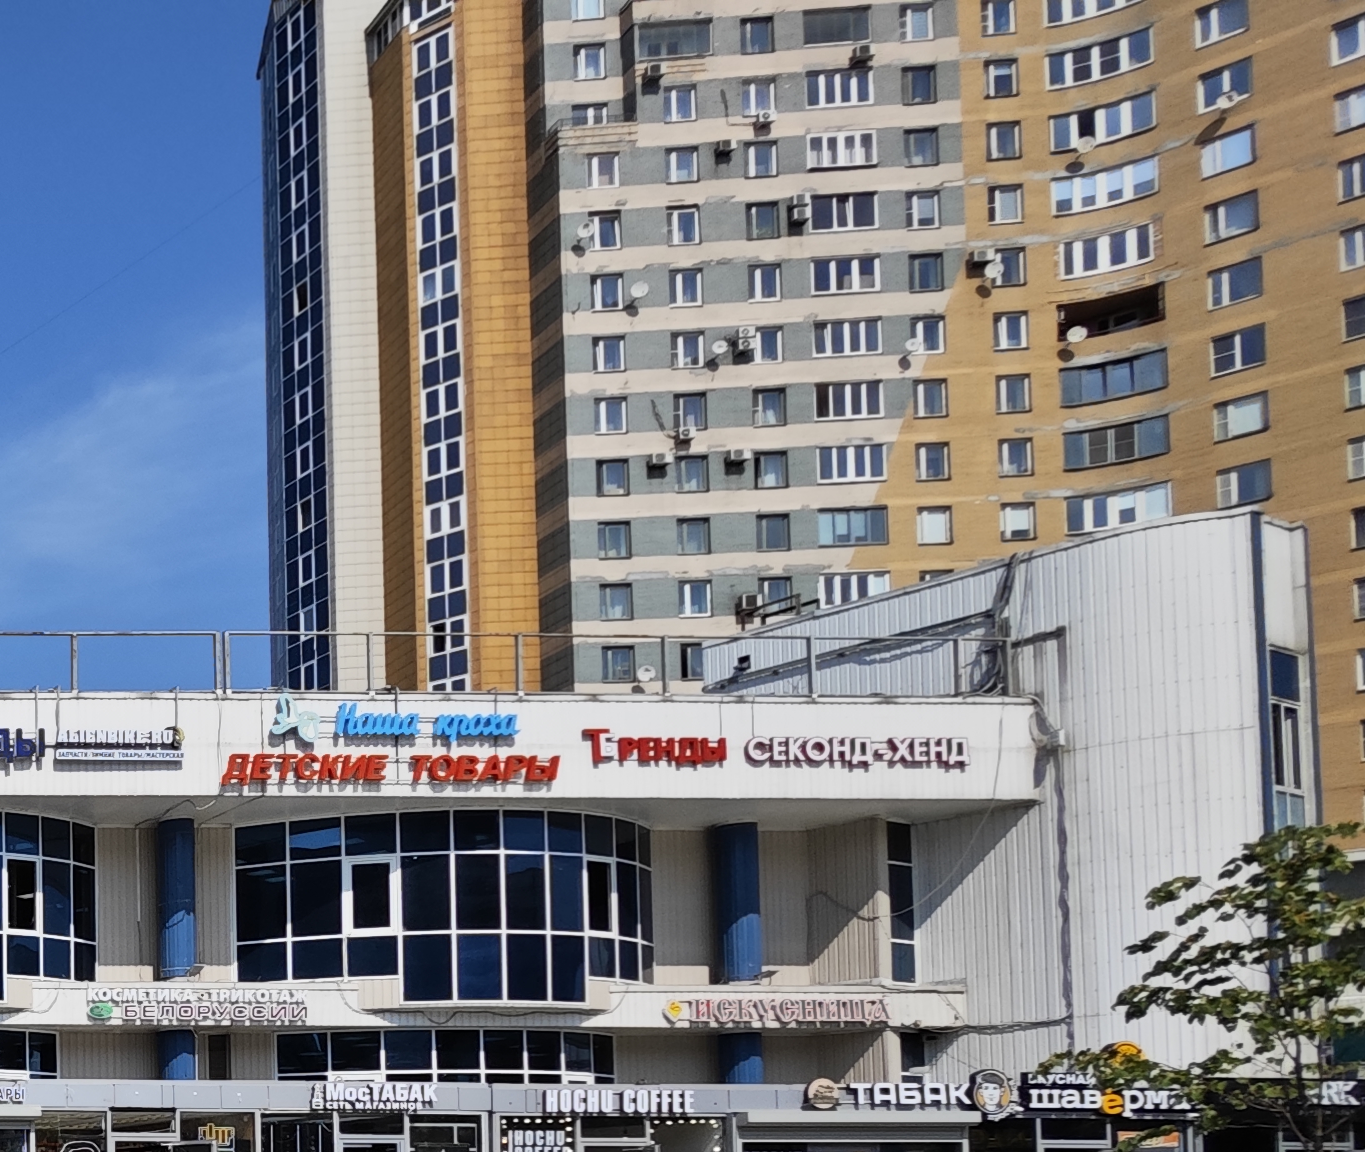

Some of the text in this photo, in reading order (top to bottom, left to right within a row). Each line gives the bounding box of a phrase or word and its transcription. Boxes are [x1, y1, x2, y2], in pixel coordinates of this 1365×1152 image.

[335, 702, 521, 742] Наша кроха
[745, 736, 971, 766] СЕКОНД-ХЕНД
[221, 753, 562, 786] ДЕТСКИЕ ТОВАРЫ
[87, 988, 308, 1004] КОСМЕТИКА ТРИКОТАЖ
[123, 1003, 309, 1020] БЕЛОРУССИИ
[689, 998, 892, 1024] ИСКУСНИЦА
[325, 1082, 439, 1102] МосТАБАК
[545, 1089, 696, 1113] HOCHU COFFEE
[849, 1082, 973, 1105] ТАБАК
[513, 1130, 566, 1146] HOCHU
